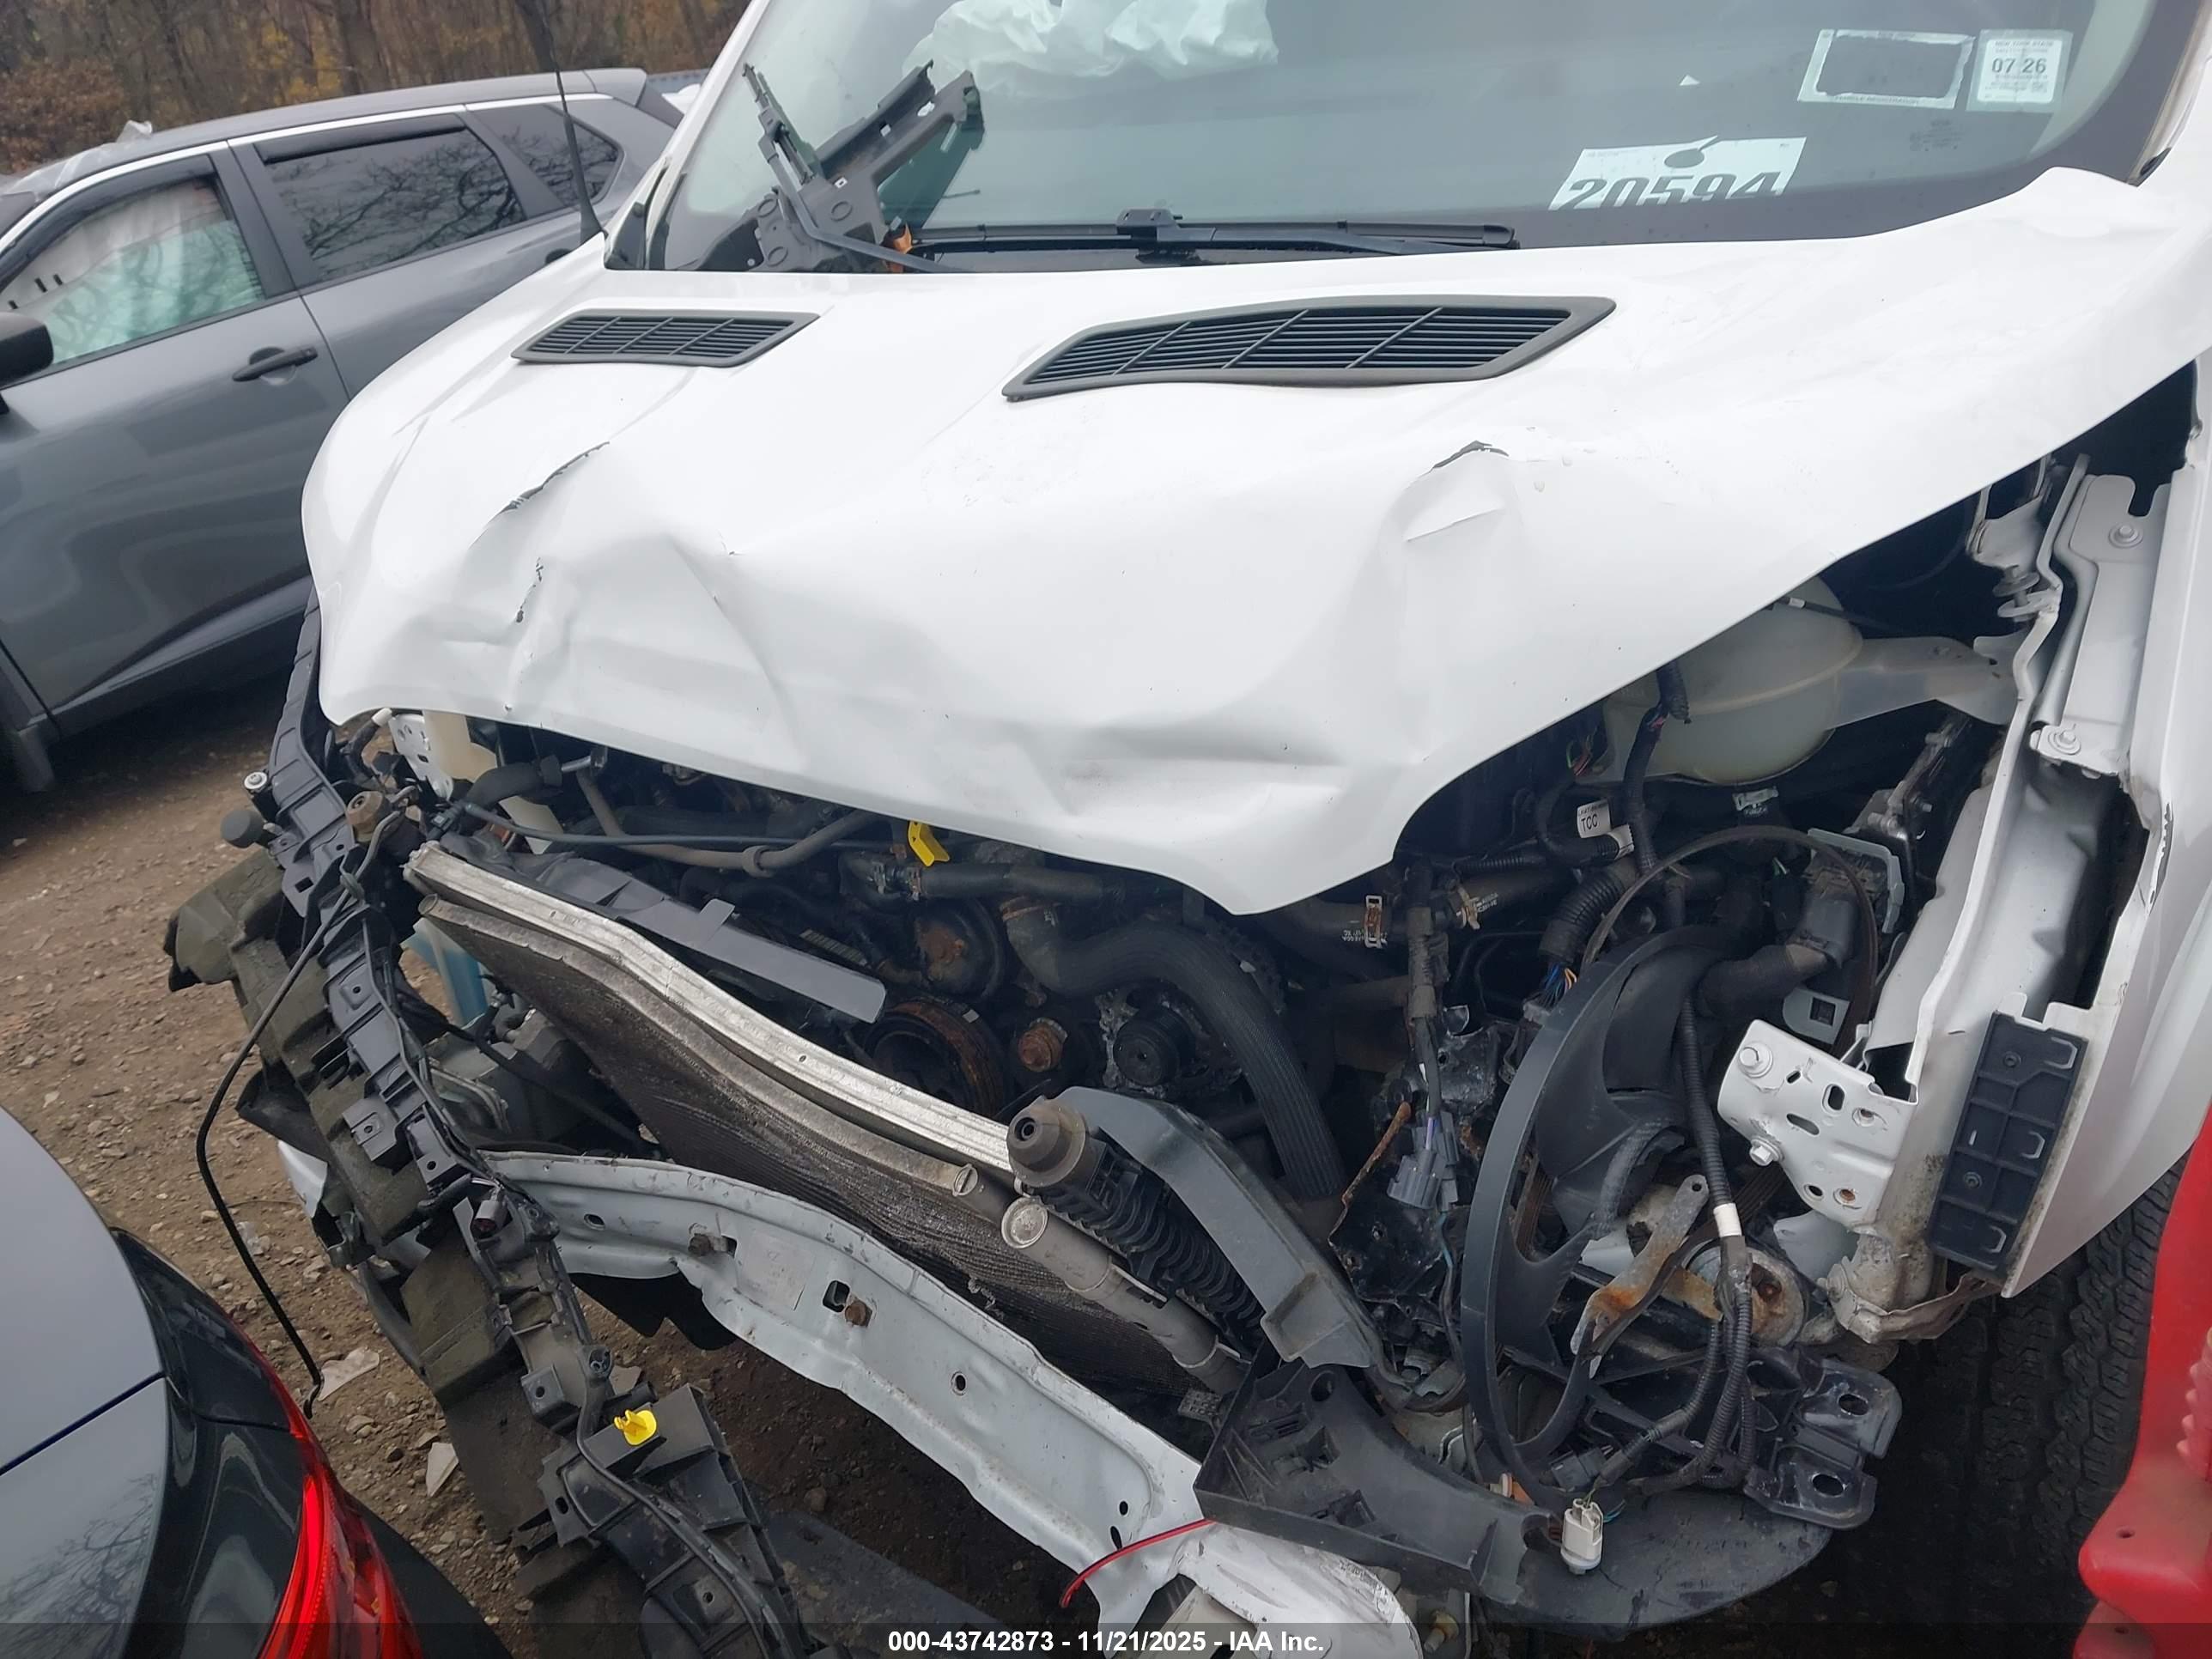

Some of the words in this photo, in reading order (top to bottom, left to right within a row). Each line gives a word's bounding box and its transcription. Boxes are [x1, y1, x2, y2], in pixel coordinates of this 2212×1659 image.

[1991, 58, 2016, 74] 07
[2021, 58, 2047, 74] 26
[1557, 171, 1782, 211] 20594
[1581, 813, 1598, 832] TCC
